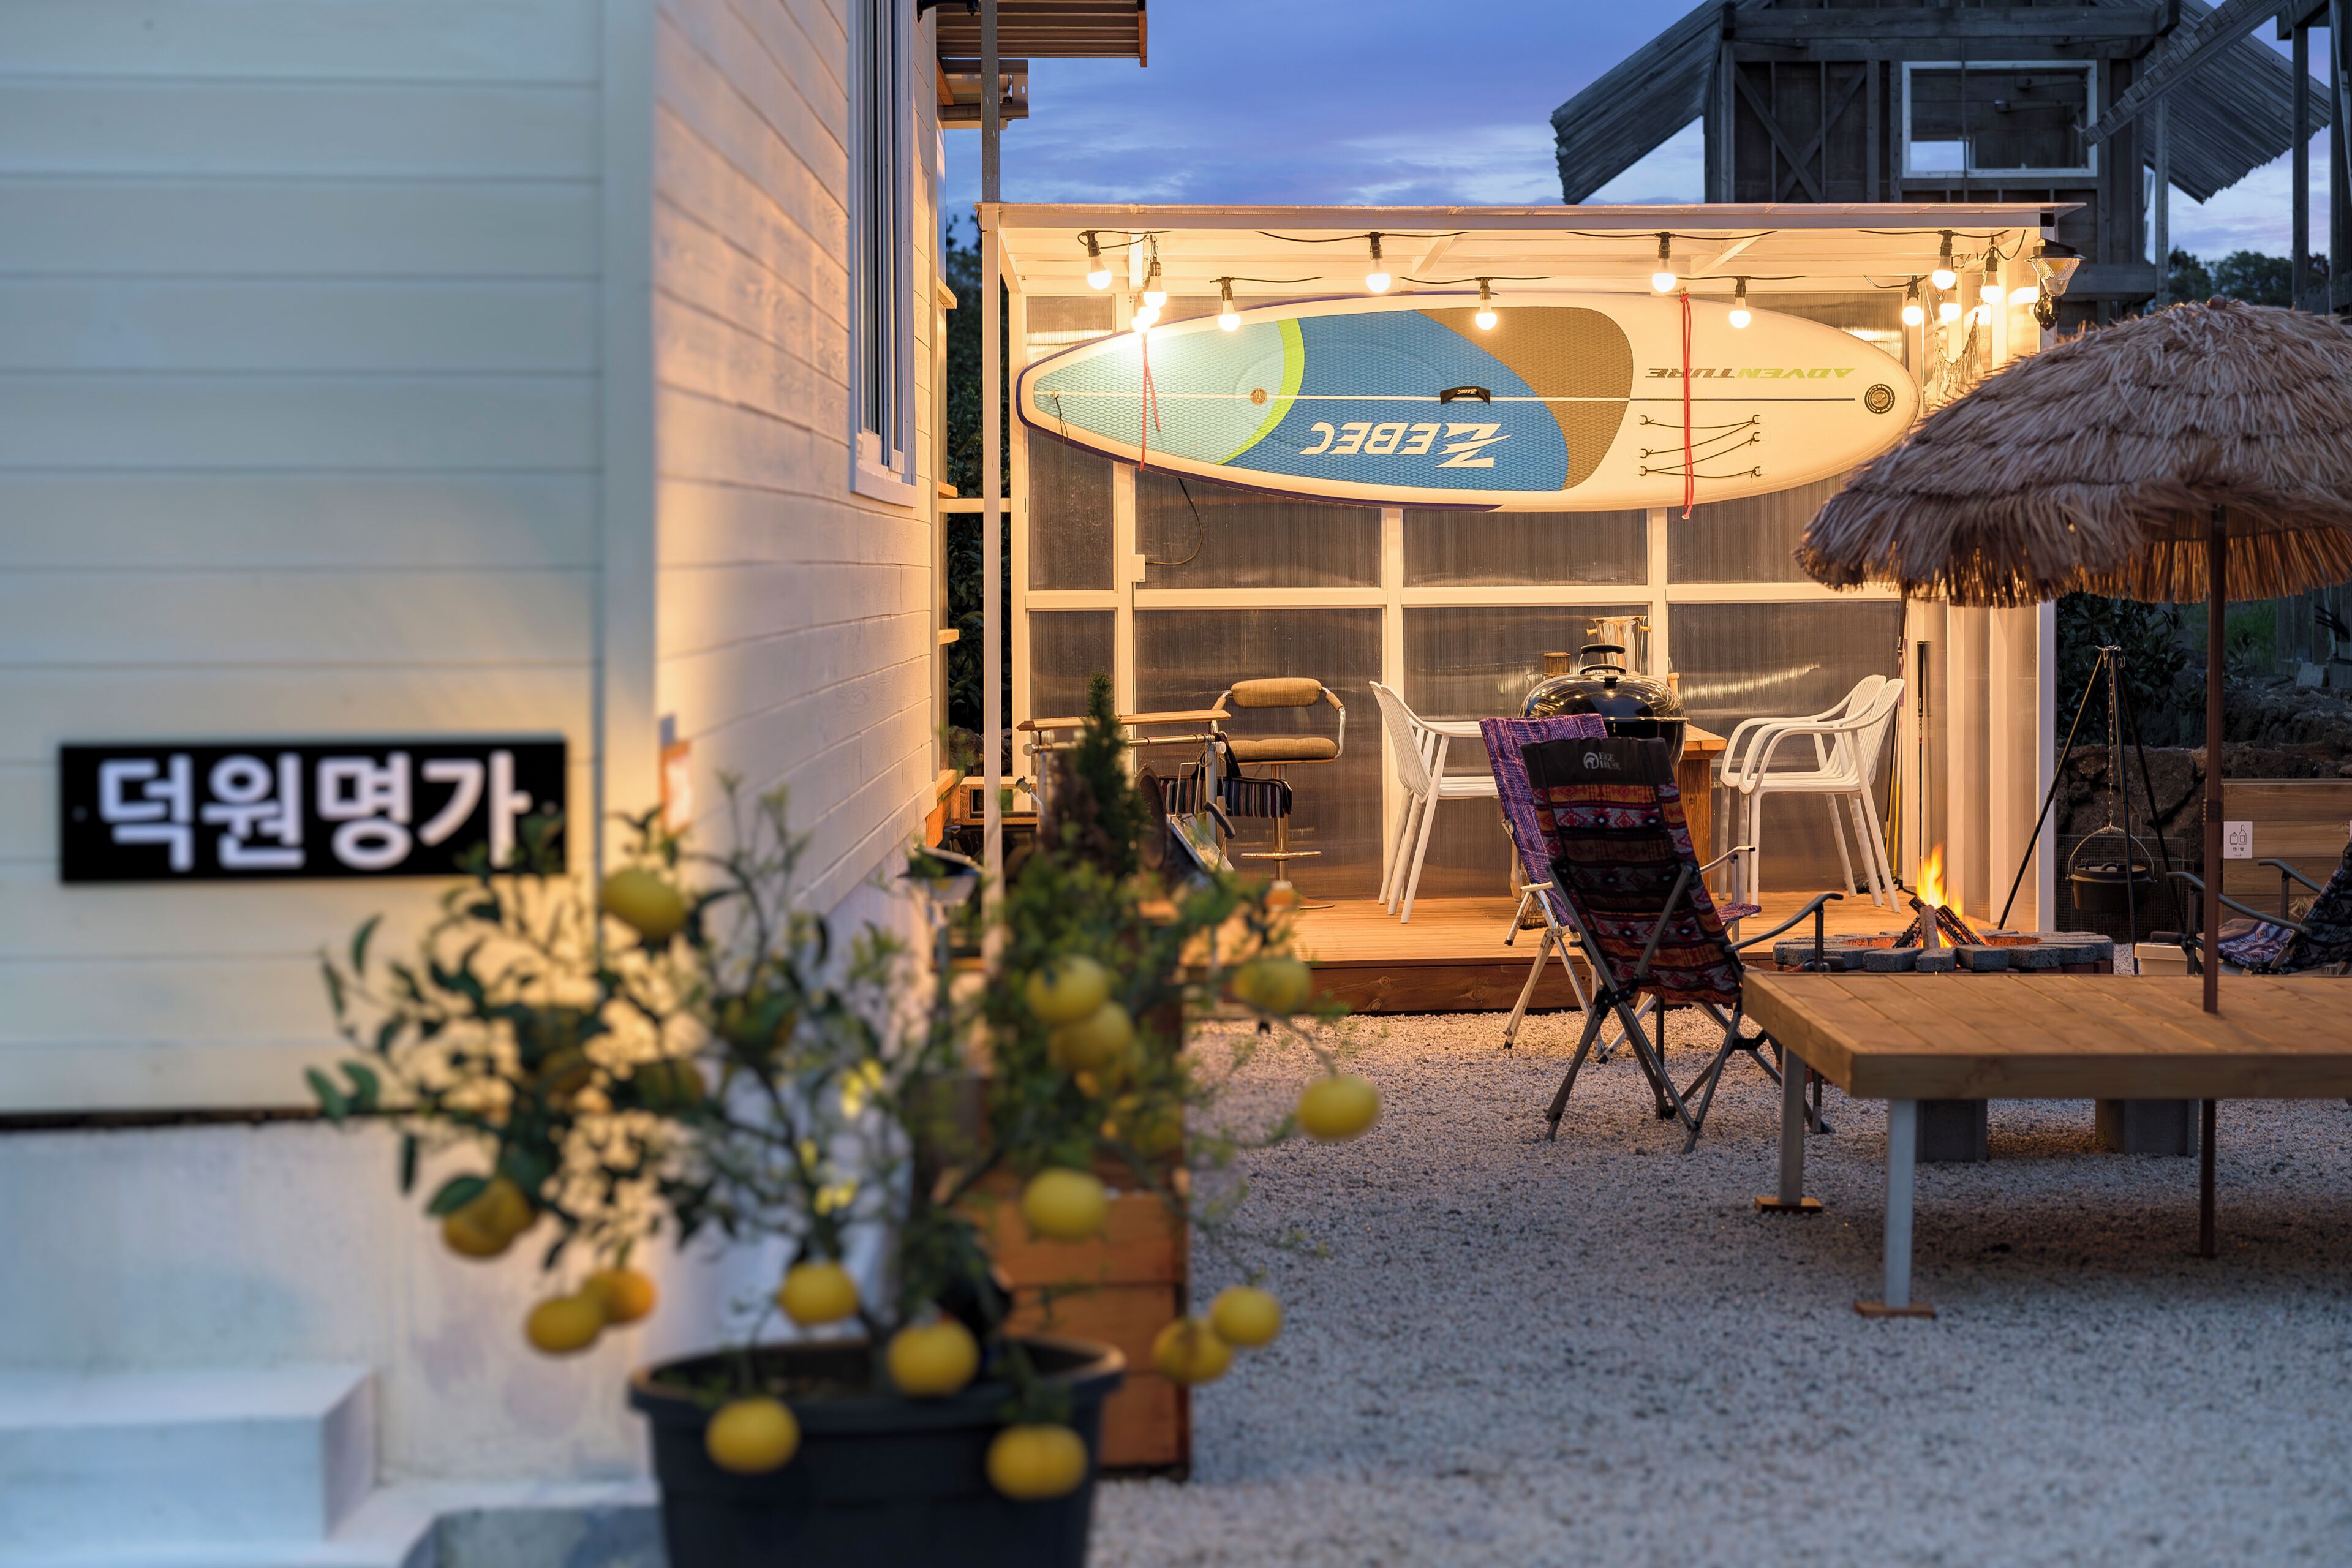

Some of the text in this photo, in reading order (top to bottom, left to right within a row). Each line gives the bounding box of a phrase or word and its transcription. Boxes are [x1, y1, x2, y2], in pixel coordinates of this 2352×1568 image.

[1645, 368, 1856, 379] ADVENTURE
[1298, 421, 1512, 469] ZEBEC
[98, 750, 533, 872] 덕원명가
